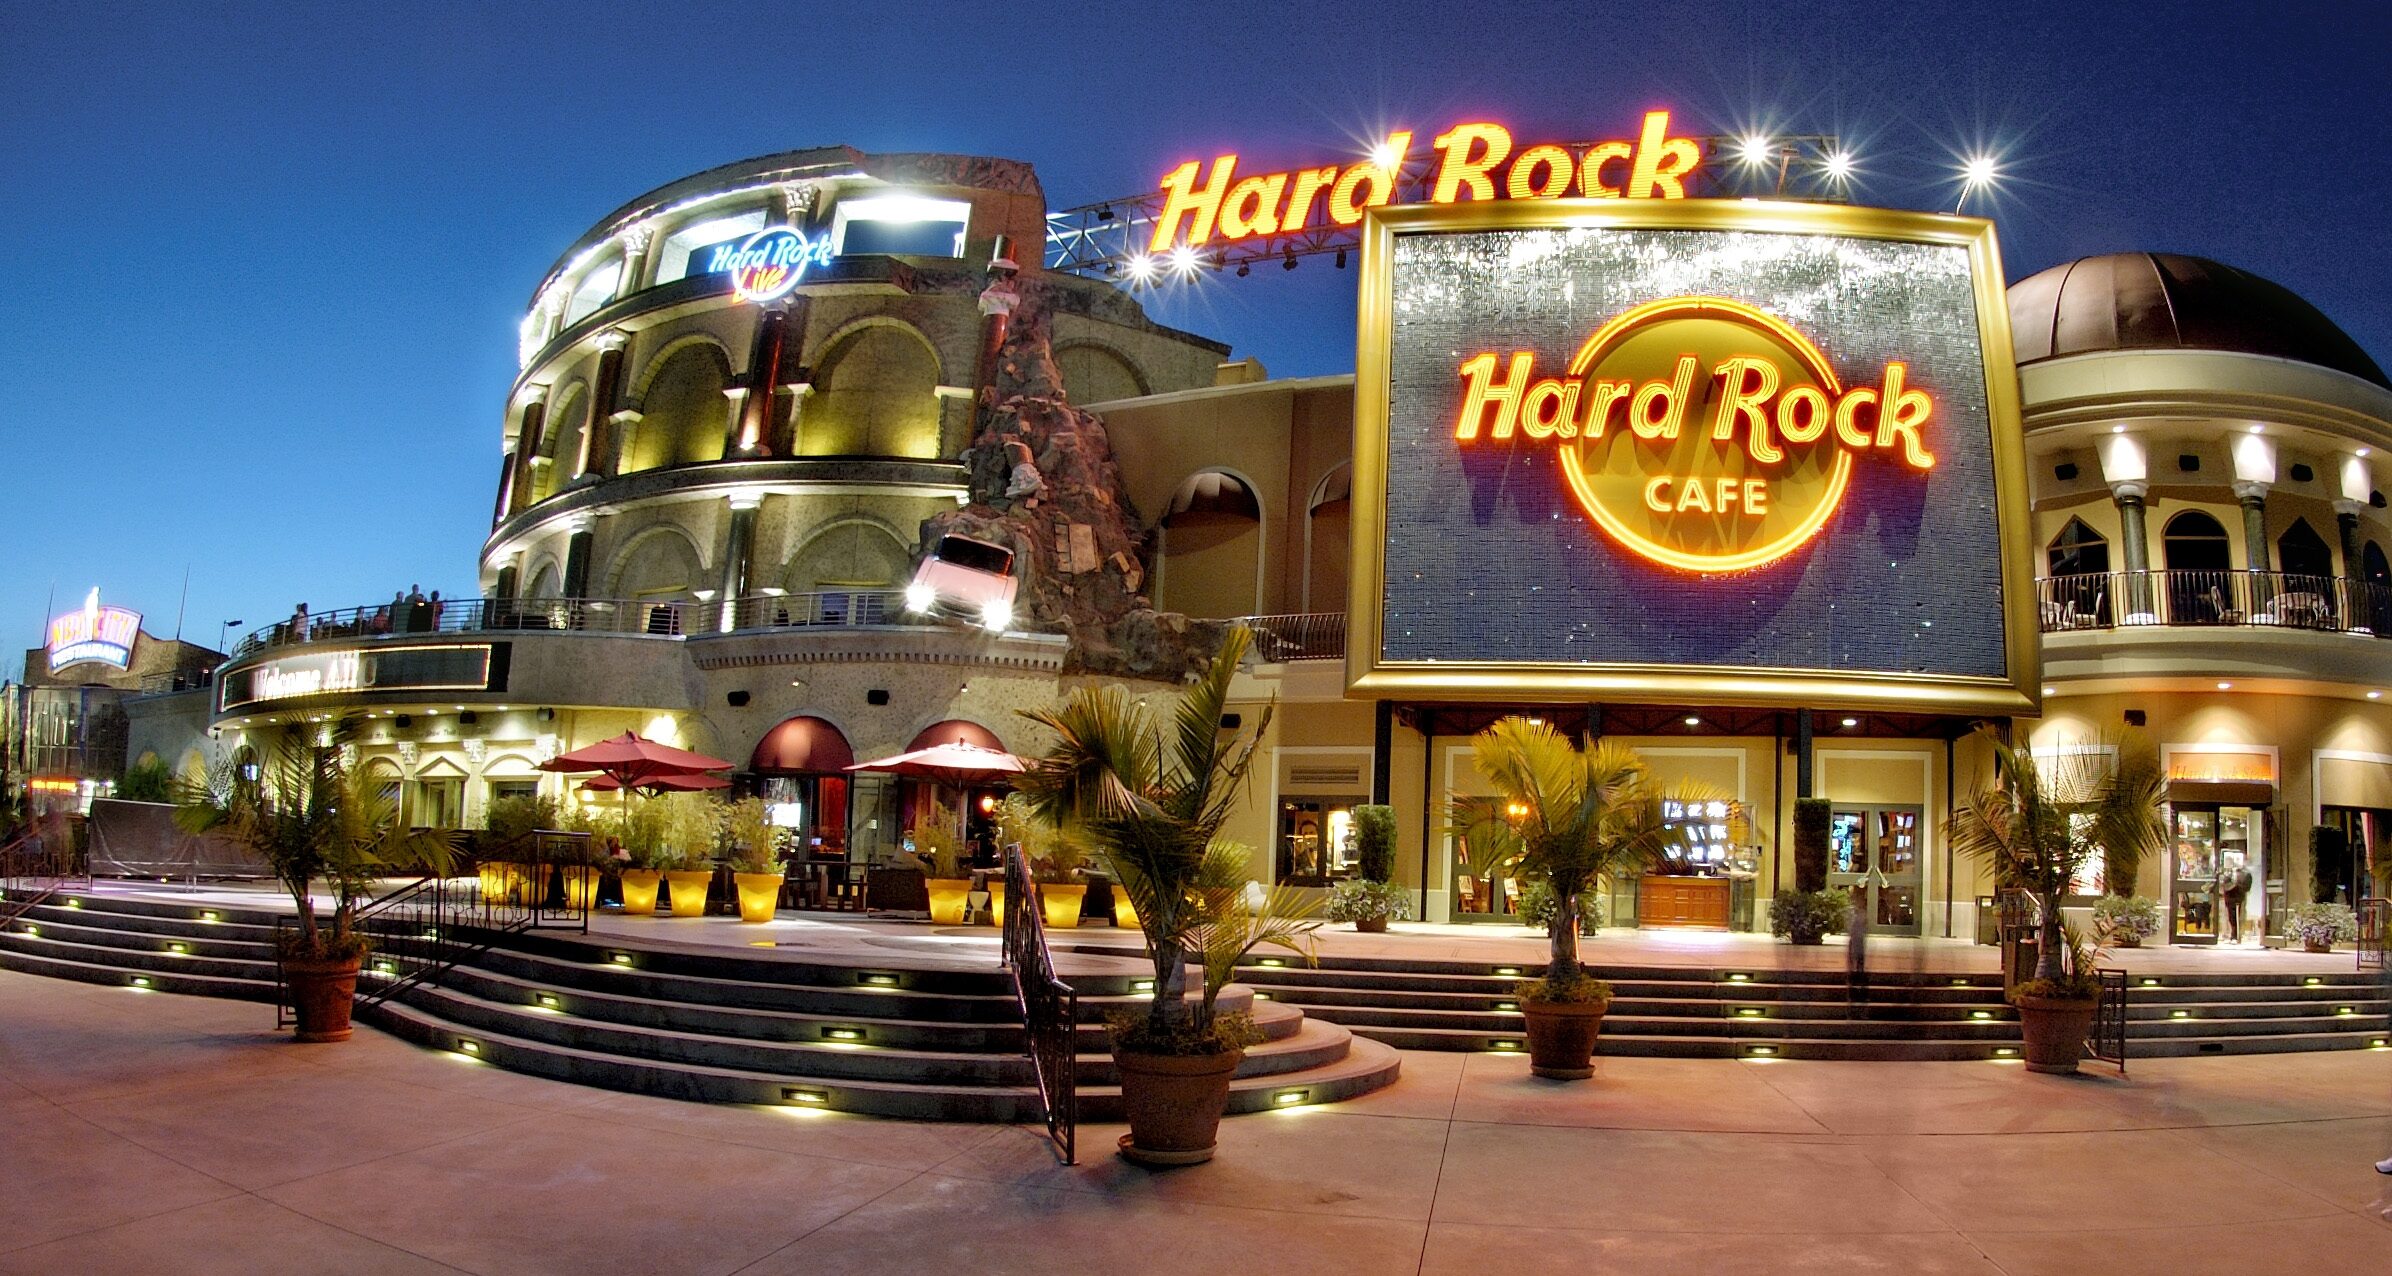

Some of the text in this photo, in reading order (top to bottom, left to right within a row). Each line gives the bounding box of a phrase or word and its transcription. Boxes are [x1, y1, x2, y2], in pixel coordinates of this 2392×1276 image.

[1149, 110, 1701, 254] Hard Rock
[708, 233, 832, 273] Hard Rock
[732, 266, 787, 304] Live
[1455, 351, 1937, 470] Hard Rock
[1643, 475, 1768, 516] CAFE
[254, 666, 321, 698] Welcome
